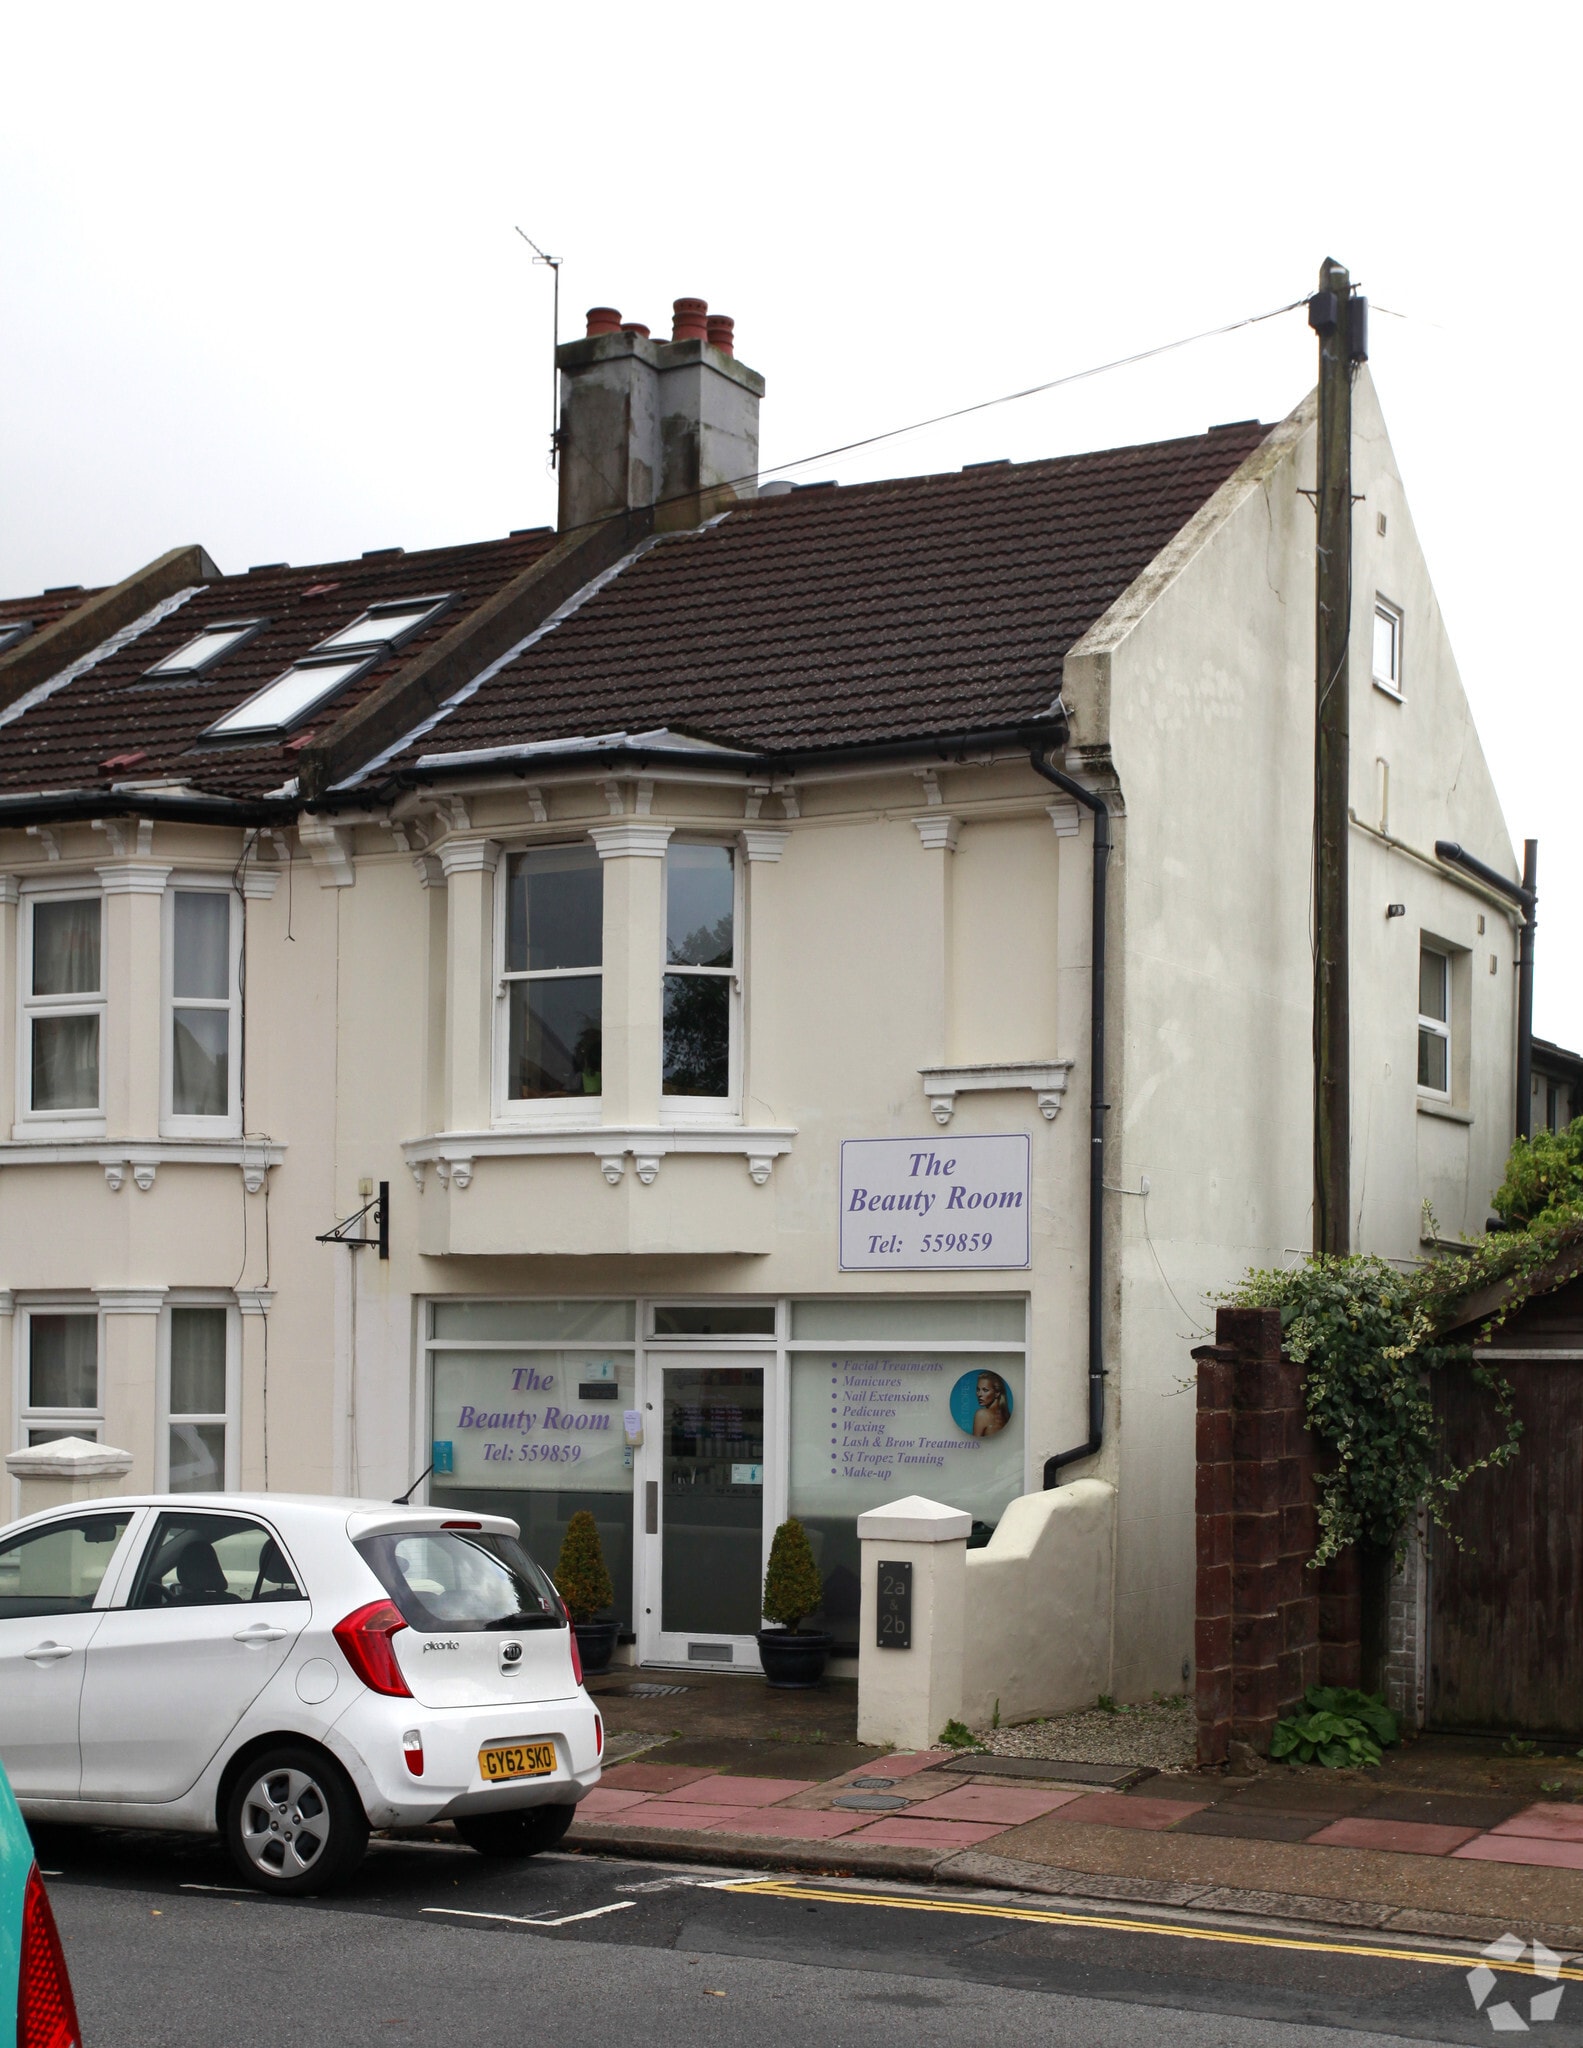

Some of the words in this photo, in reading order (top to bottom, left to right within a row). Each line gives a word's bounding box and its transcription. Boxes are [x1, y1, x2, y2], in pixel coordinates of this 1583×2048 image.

[908, 1152, 957, 1177] The
[847, 1187, 937, 1217] Beauty
[944, 1185, 1024, 1210] Room
[867, 1234, 903, 1254] Tel:
[920, 1231, 993, 1253] 559859
[843, 1359, 879, 1372] Facial
[880, 1359, 944, 1373] Treatments
[511, 1367, 554, 1392] The
[842, 1375, 902, 1388] Manicures
[842, 1390, 868, 1403] Nail
[868, 1390, 930, 1404] Extensions
[842, 1405, 897, 1418] Pedicures
[457, 1405, 537, 1436] Beauty
[541, 1406, 611, 1431] Room
[842, 1420, 886, 1435] Waxing
[842, 1436, 871, 1449] Lash
[871, 1436, 882, 1449] &
[884, 1437, 916, 1449] Brow
[917, 1437, 982, 1451] Treatments
[483, 1443, 515, 1462] Tel:
[518, 1444, 582, 1463] 559859
[841, 1451, 854, 1464] St
[855, 1451, 894, 1465] Tropez
[896, 1452, 945, 1467] Tanning
[841, 1467, 892, 1481] Make-up
[883, 1576, 905, 1595] 2a
[882, 1615, 905, 1633] 2b
[423, 1640, 459, 1653] picanto
[486, 1749, 525, 1774] GY62
